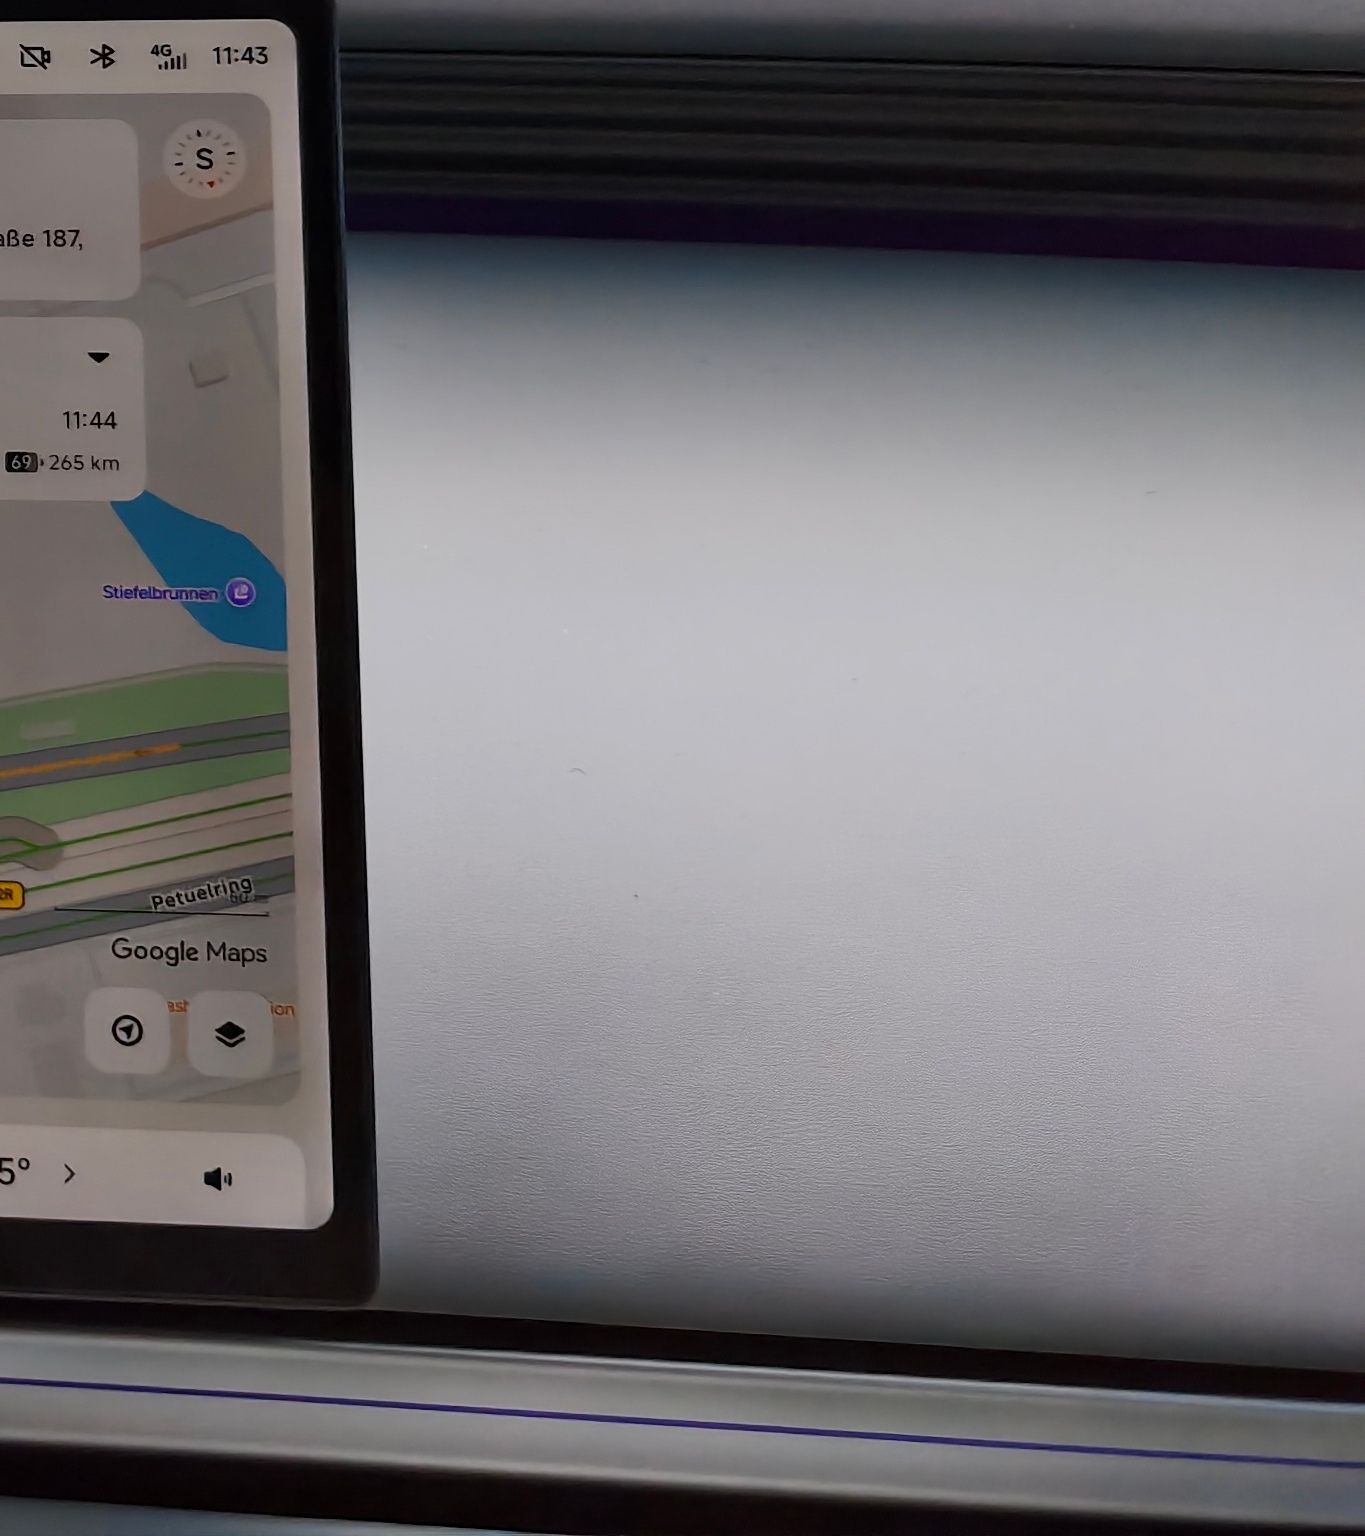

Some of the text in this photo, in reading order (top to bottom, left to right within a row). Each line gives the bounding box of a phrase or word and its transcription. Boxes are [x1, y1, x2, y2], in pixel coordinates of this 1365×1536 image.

[150, 43, 173, 58] 4G
[212, 46, 269, 65] 11:43
[195, 147, 213, 171] S
[42, 229, 83, 251] 187,
[62, 410, 118, 430] 11:44
[11, 454, 31, 470] 69
[48, 454, 120, 471] 265 km
[103, 584, 219, 602] Stiefelbrunnen
[151, 877, 253, 911] Petuelring
[111, 937, 268, 968] Google Maps
